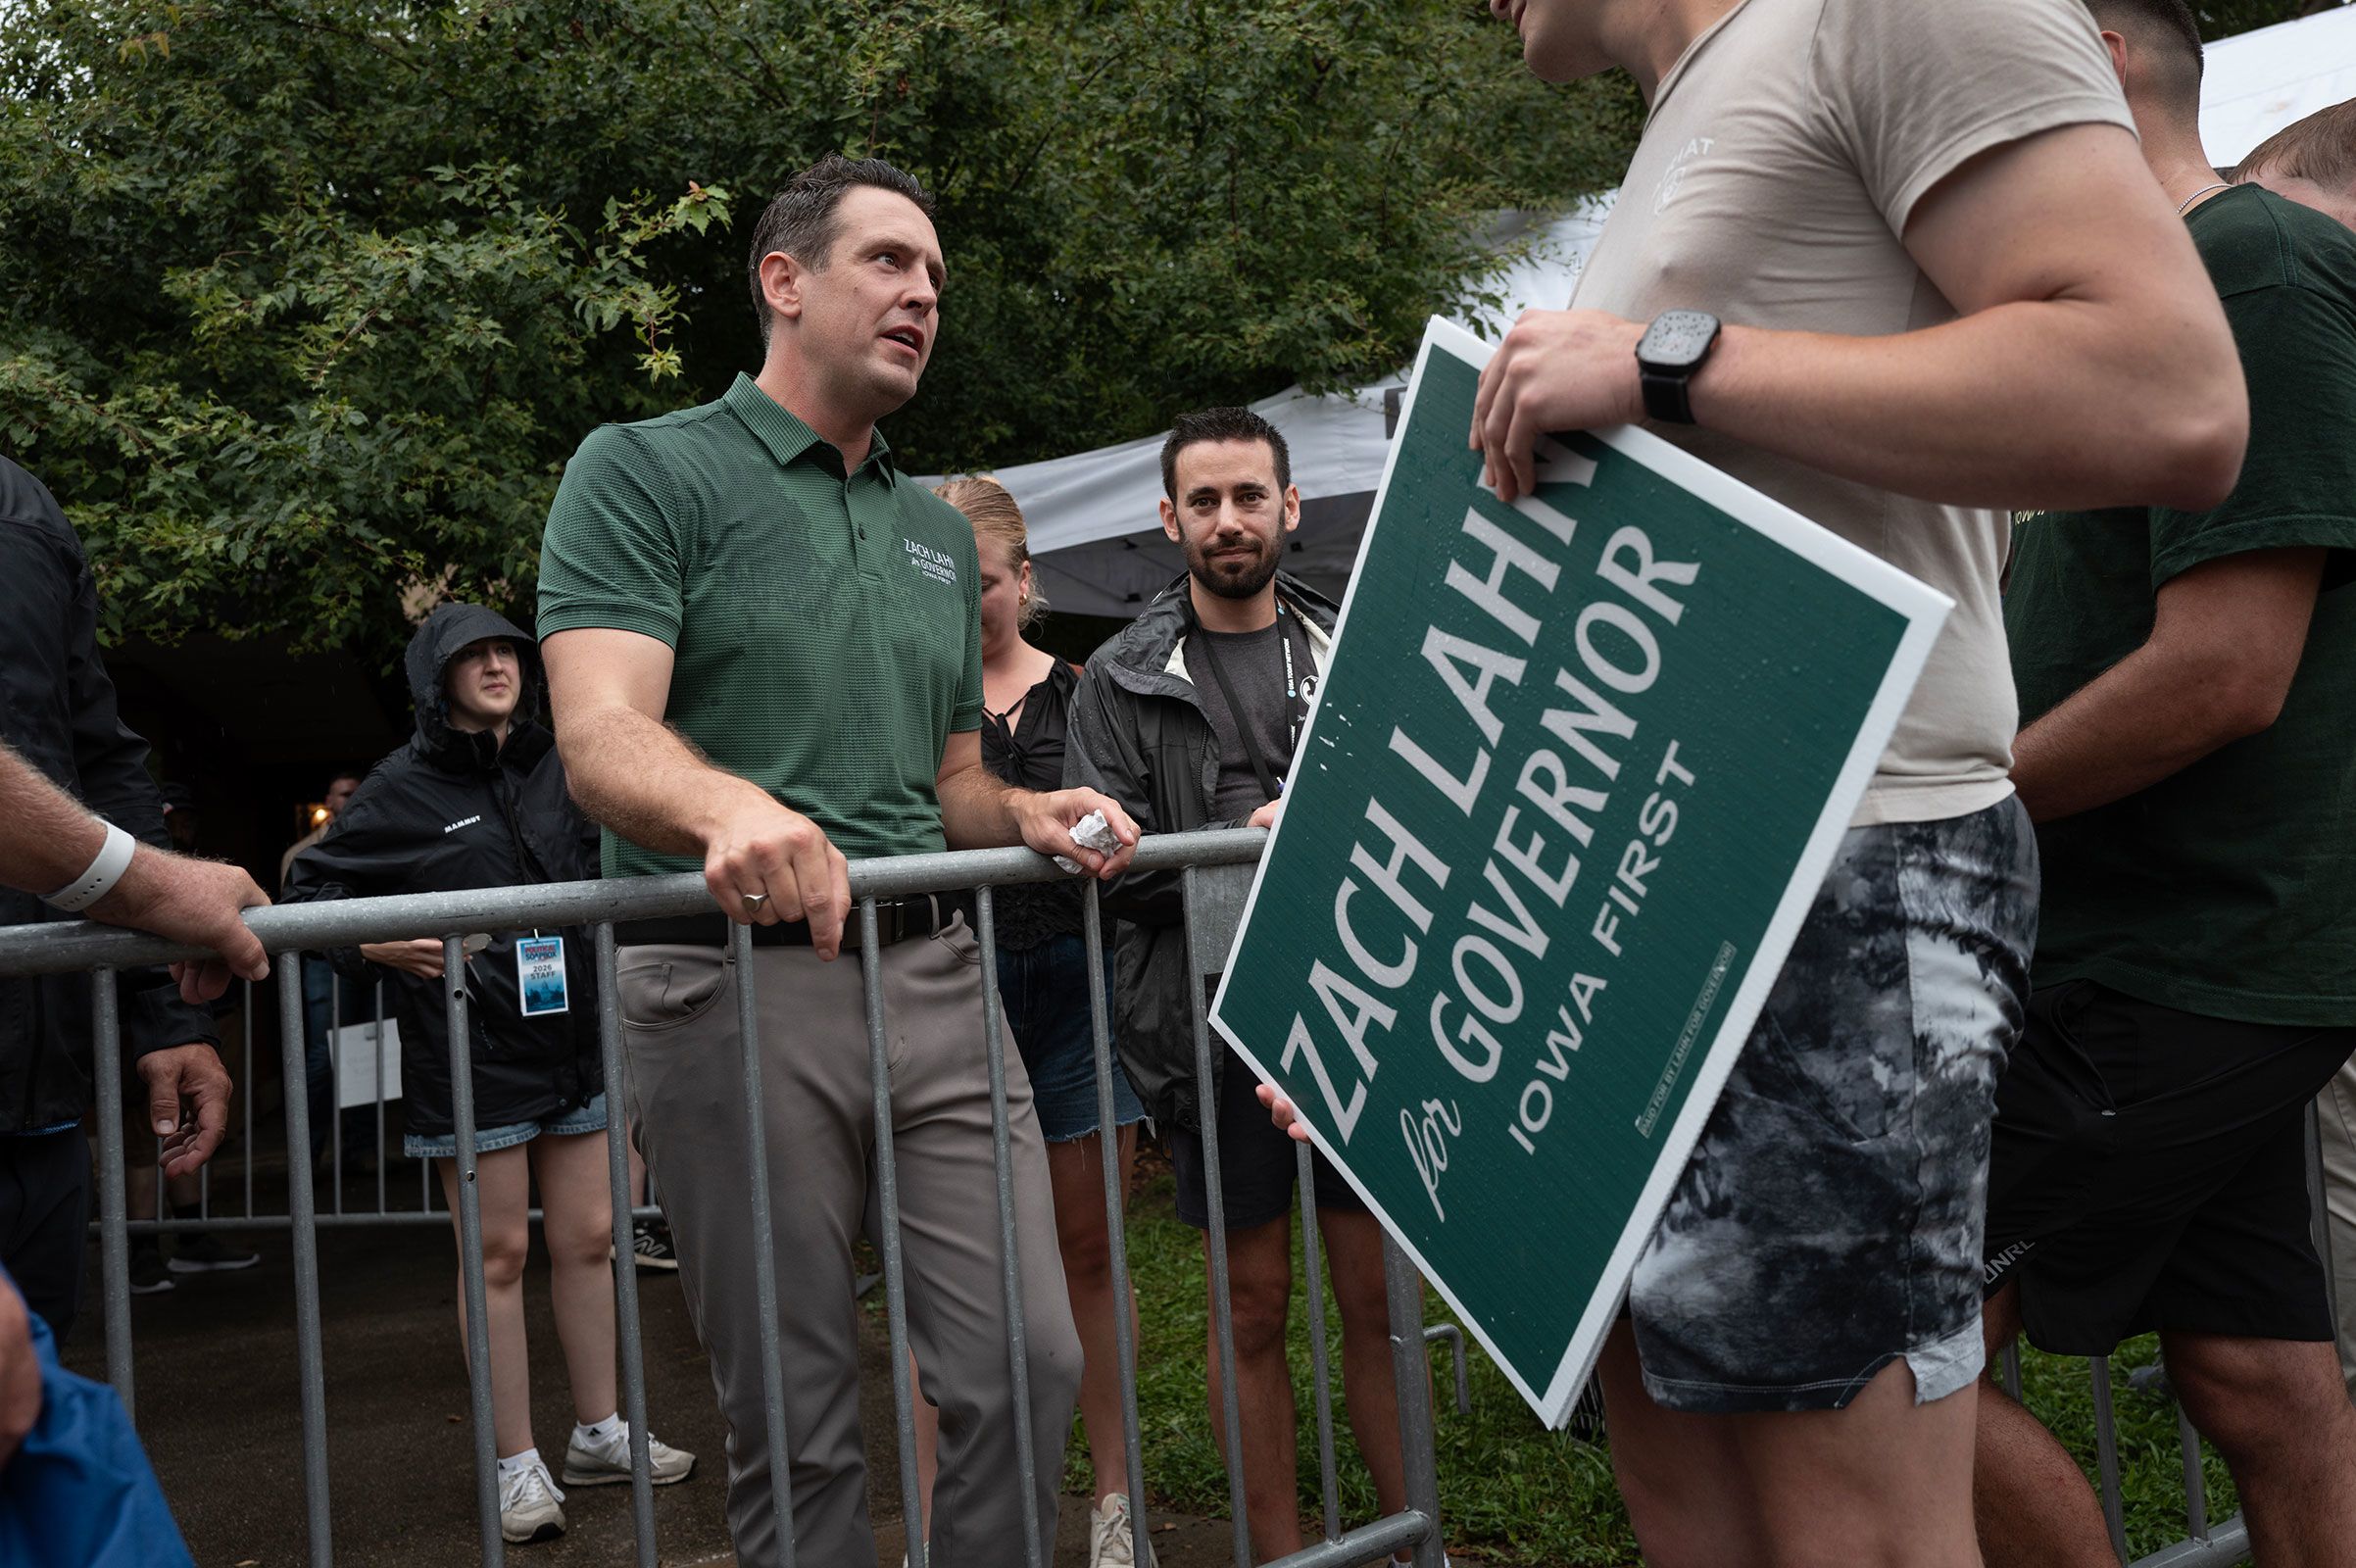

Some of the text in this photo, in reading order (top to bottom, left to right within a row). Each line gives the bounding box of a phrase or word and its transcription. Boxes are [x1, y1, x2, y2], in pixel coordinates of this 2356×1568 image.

[903, 538, 930, 560] ZACH
[444, 814, 480, 833] MAMMUT
[1399, 525, 1700, 1222] for GOVERNOR
[530, 971, 556, 980] STAFF
[533, 964, 553, 973] 2026
[1279, 796, 1452, 1147] ZACH
[1508, 739, 1694, 1154] IOWA FIRST
[1640, 1106, 1657, 1136] PAID
[1653, 1085, 1667, 1106] FOR
[1664, 1067, 1677, 1087] BY
[1672, 1036, 1691, 1069] LAHN
[1688, 1012, 1703, 1035] FOR
